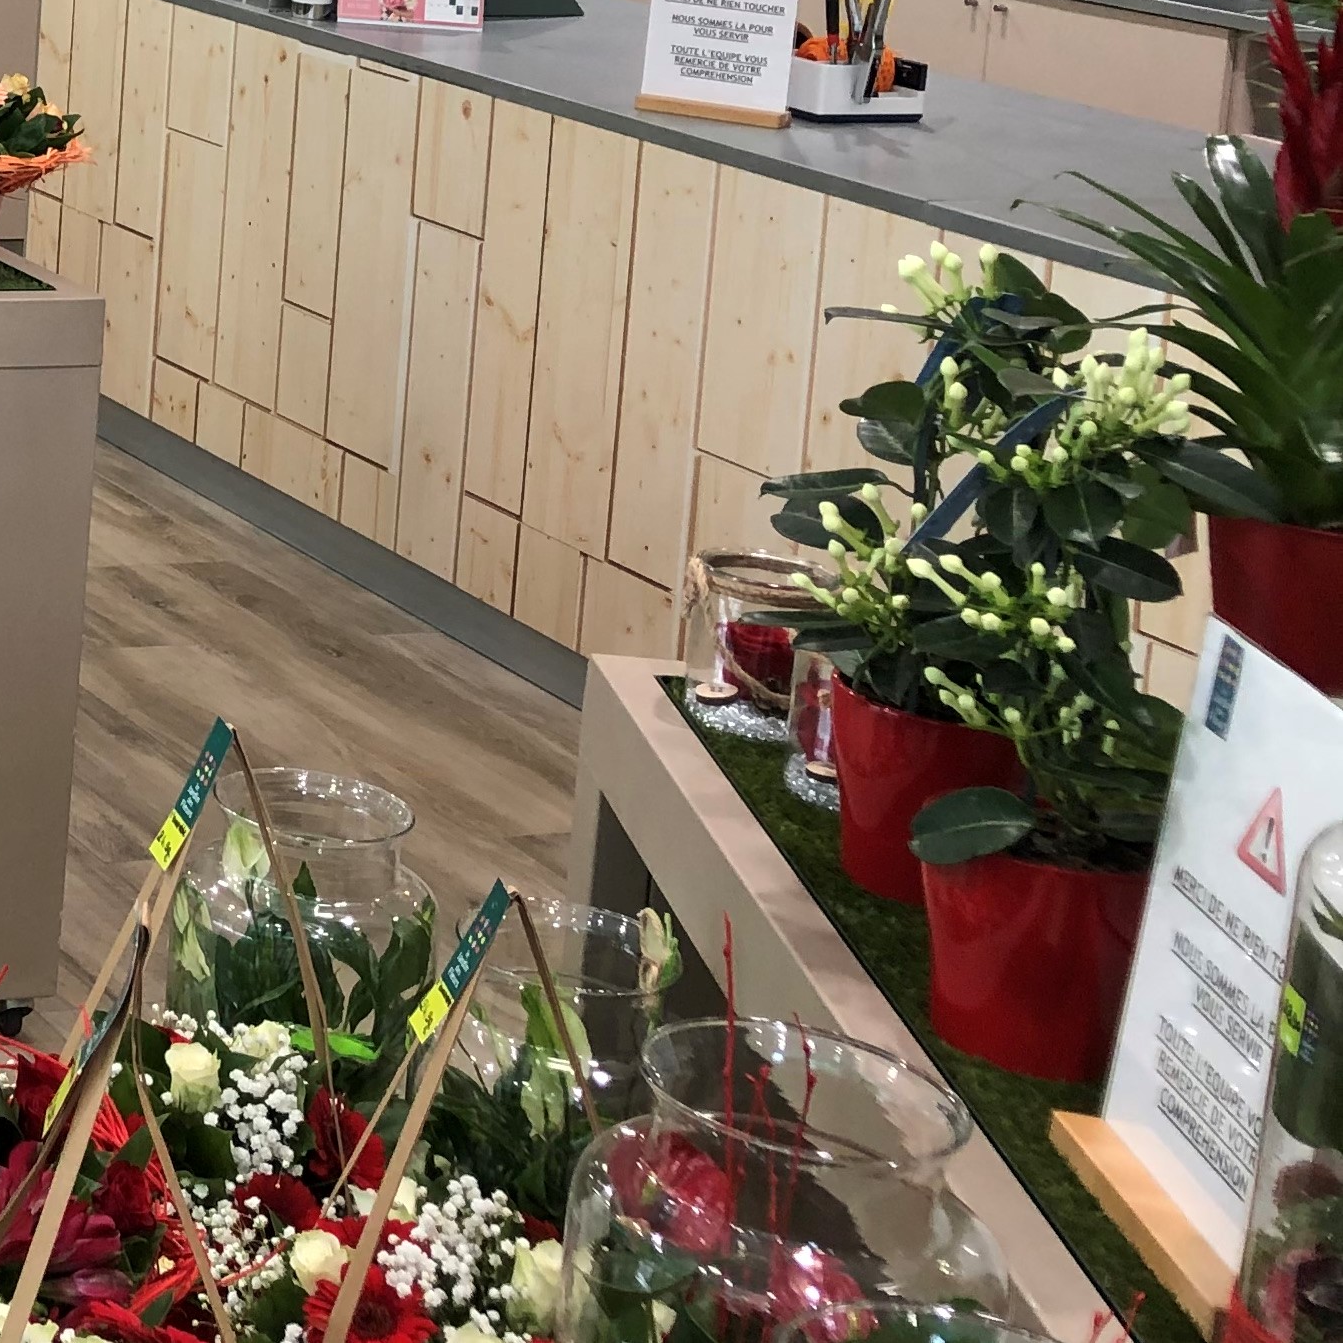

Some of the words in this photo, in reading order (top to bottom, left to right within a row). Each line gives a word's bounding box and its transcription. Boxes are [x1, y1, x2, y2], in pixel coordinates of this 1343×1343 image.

[672, 14, 695, 23] NOUS
[698, 16, 732, 28] SOMMES
[735, 22, 746, 30] LA
[749, 24, 774, 34] POUR
[721, 0, 741, 9] RIEN
[744, 1, 786, 14] TOUCHER
[671, 44, 699, 55] TOUTE
[745, 55, 768, 65] VOUS
[694, 27, 716, 37] VOUS
[719, 30, 749, 41] SERVIR
[674, 56, 715, 68] REMERCIE
[719, 62, 729, 71] DE
[733, 64, 761, 74] VOTRE
[680, 67, 753, 84] COMPREHENSION
[1174, 865, 1206, 903] MERCI
[1207, 894, 1224, 921] DE
[1225, 910, 1243, 939] NE
[1242, 925, 1270, 961] RIEN
[1173, 931, 1203, 970] NOUS
[1204, 959, 1249, 1014] SOMMES
[1250, 1003, 1264, 1033] LA
[1195, 983, 1225, 1026] VOUS
[1225, 1015, 1264, 1064] SERVIR
[1159, 1014, 1195, 1068] TOUTE
[1248, 1109, 1262, 1138] VO
[1158, 1049, 1208, 1113] REMERCIE
[1210, 1103, 1226, 1135] DE
[1228, 1123, 1258, 1169] VOTR
[1160, 1088, 1249, 1194] COMPREHENSION
